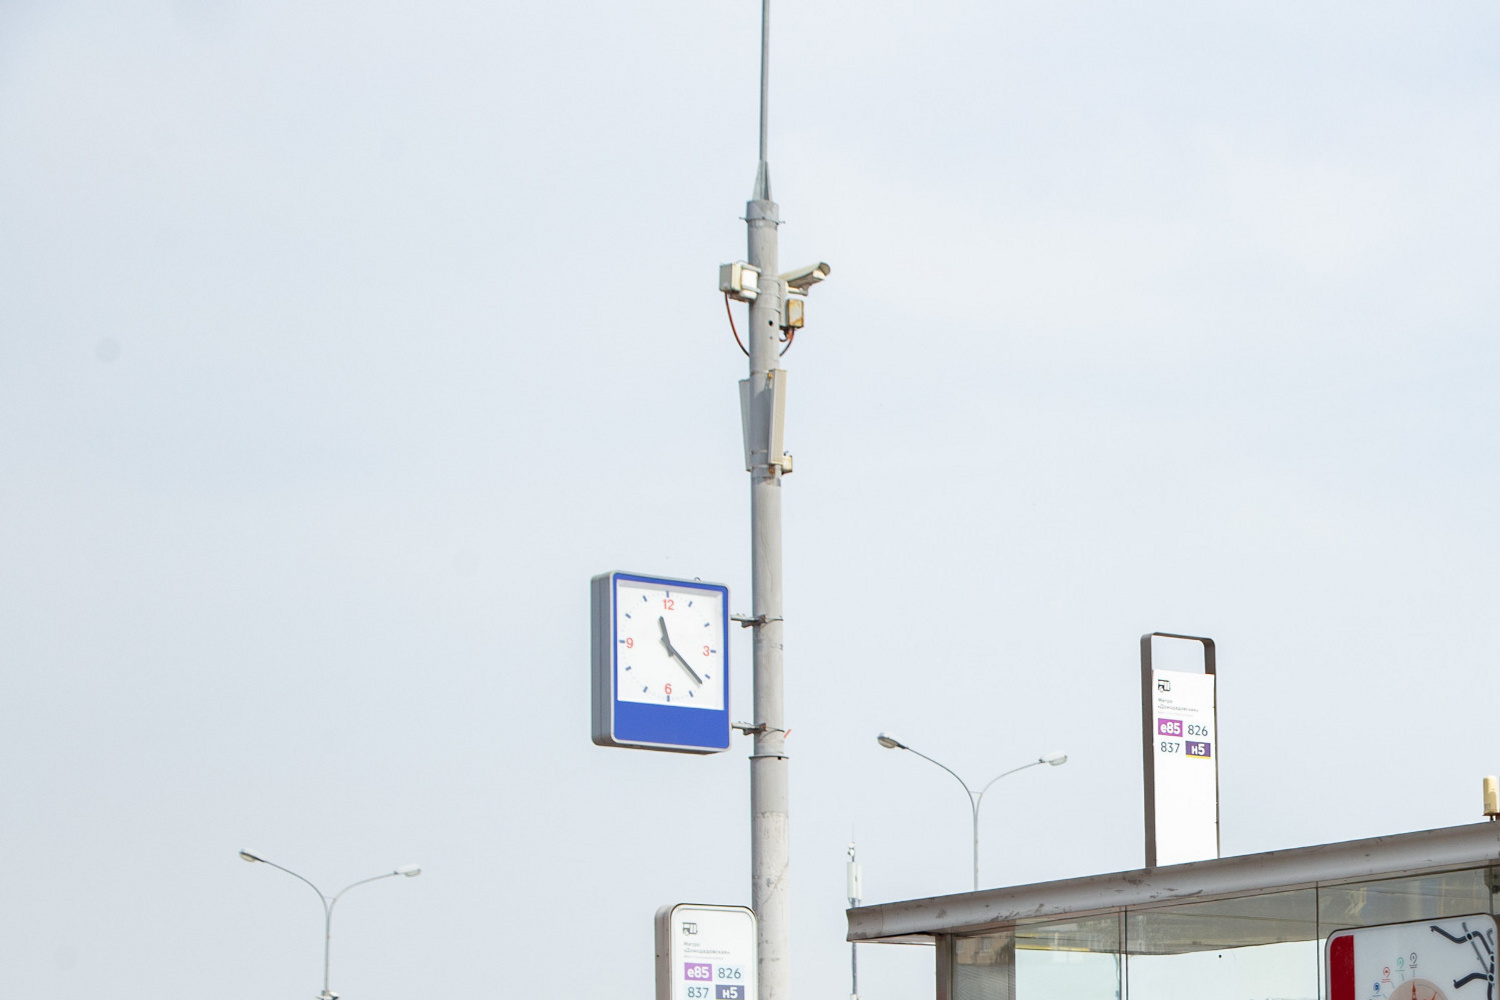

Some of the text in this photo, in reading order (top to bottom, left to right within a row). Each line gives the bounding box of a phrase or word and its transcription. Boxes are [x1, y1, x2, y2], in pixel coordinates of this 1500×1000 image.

[663, 600, 674, 610] 12
[626, 638, 633, 649] 9
[703, 646, 710, 656] 3
[664, 684, 672, 694] 6
[1187, 724, 1208, 737] 826
[1160, 741, 1206, 756] 837 н5
[718, 967, 742, 979] 826
[687, 986, 738, 999] 837 н5
